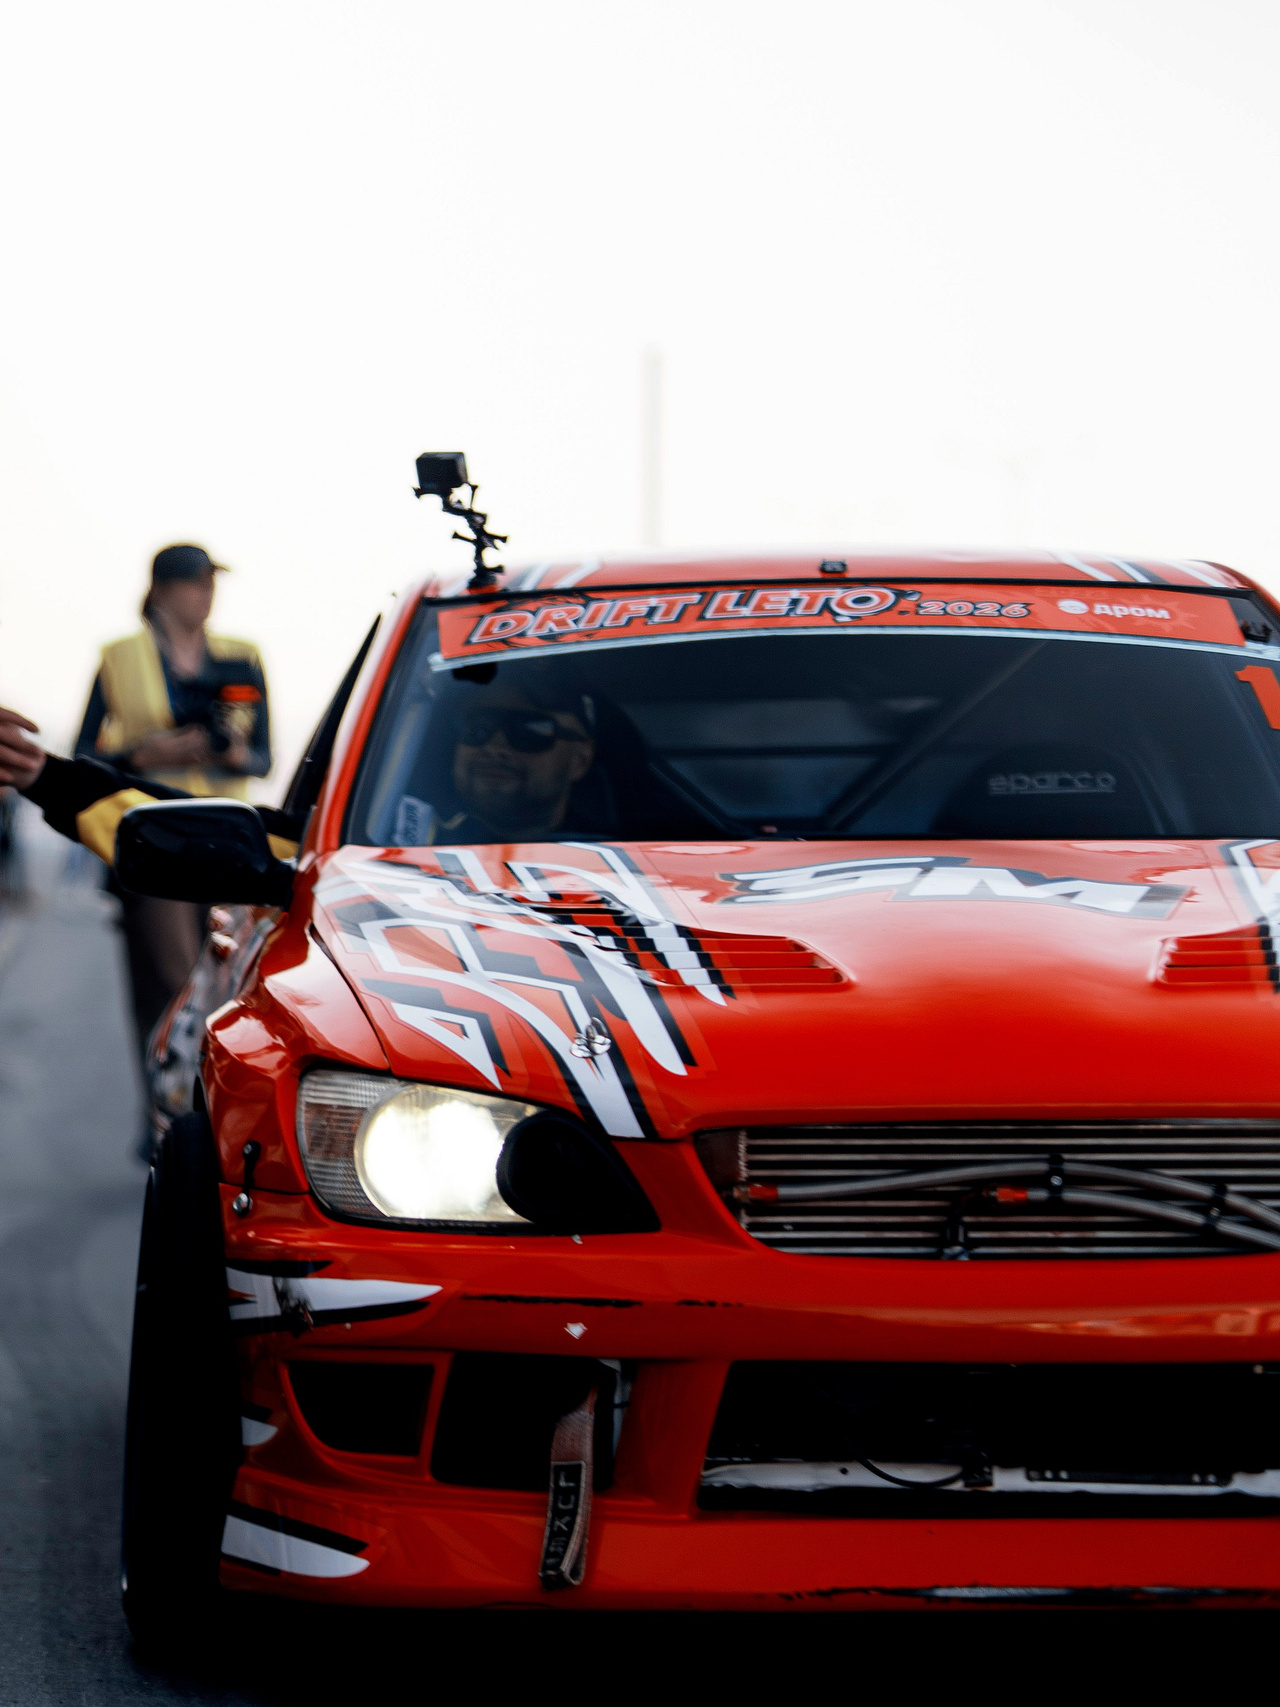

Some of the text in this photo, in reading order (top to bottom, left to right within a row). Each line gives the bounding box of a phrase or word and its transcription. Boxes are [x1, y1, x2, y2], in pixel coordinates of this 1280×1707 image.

[468, 586, 1030, 643] DRIFT LETO 2026
